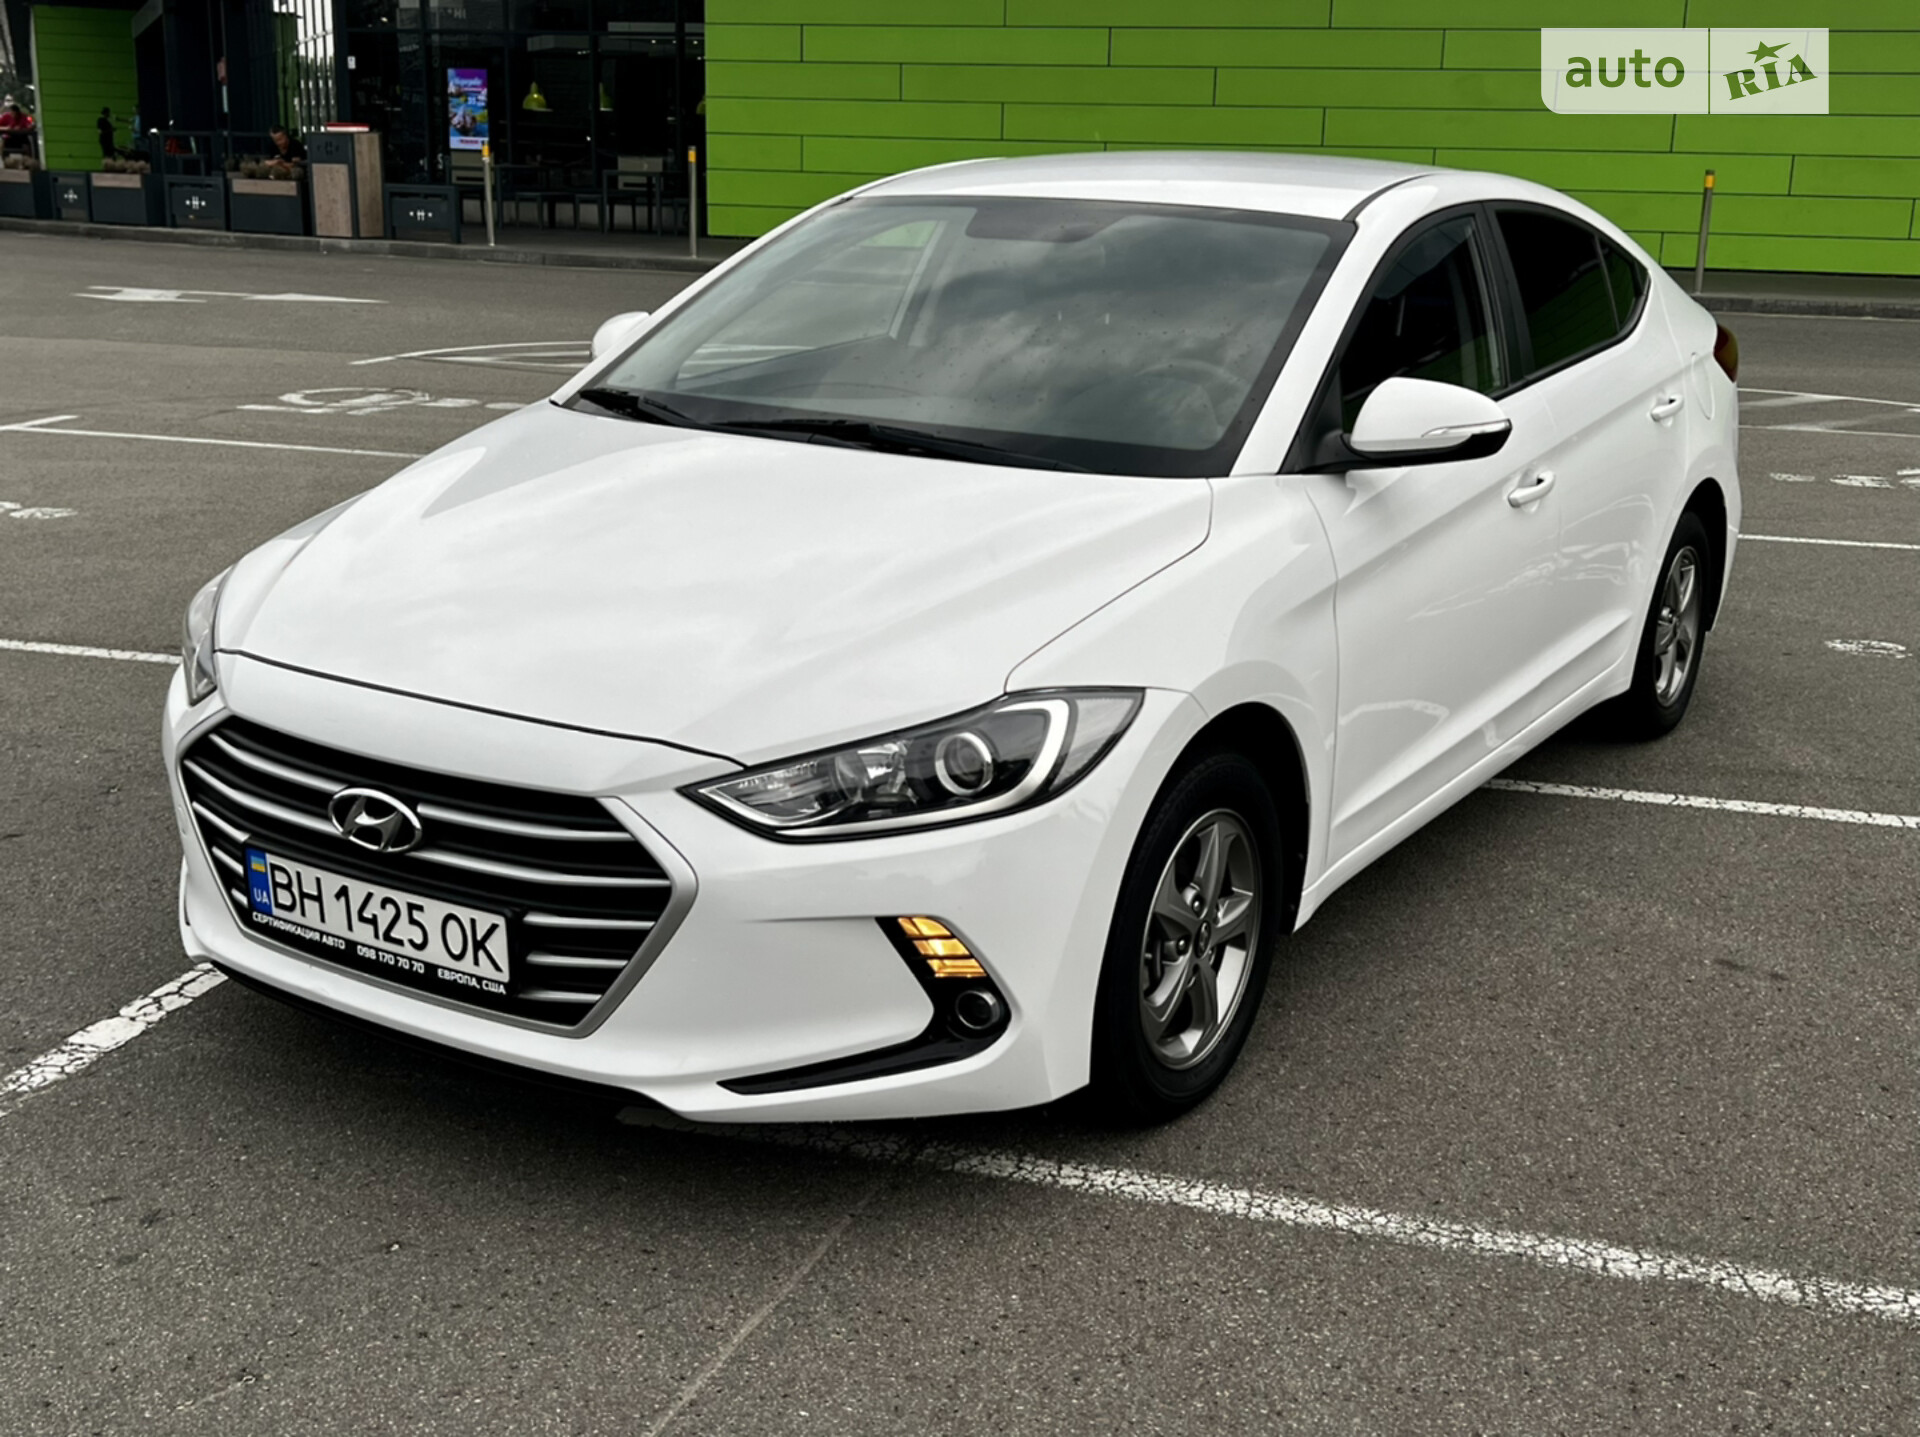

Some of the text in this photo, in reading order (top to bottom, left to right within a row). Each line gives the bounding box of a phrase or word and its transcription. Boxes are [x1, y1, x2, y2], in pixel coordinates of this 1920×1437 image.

[253, 887, 270, 906] UA
[269, 861, 504, 973] BH 1425 OK
[252, 911, 506, 995] СЕРТИФИКАЦИЯ АВТО 098 170 70 70 ЕВРОПА, США
